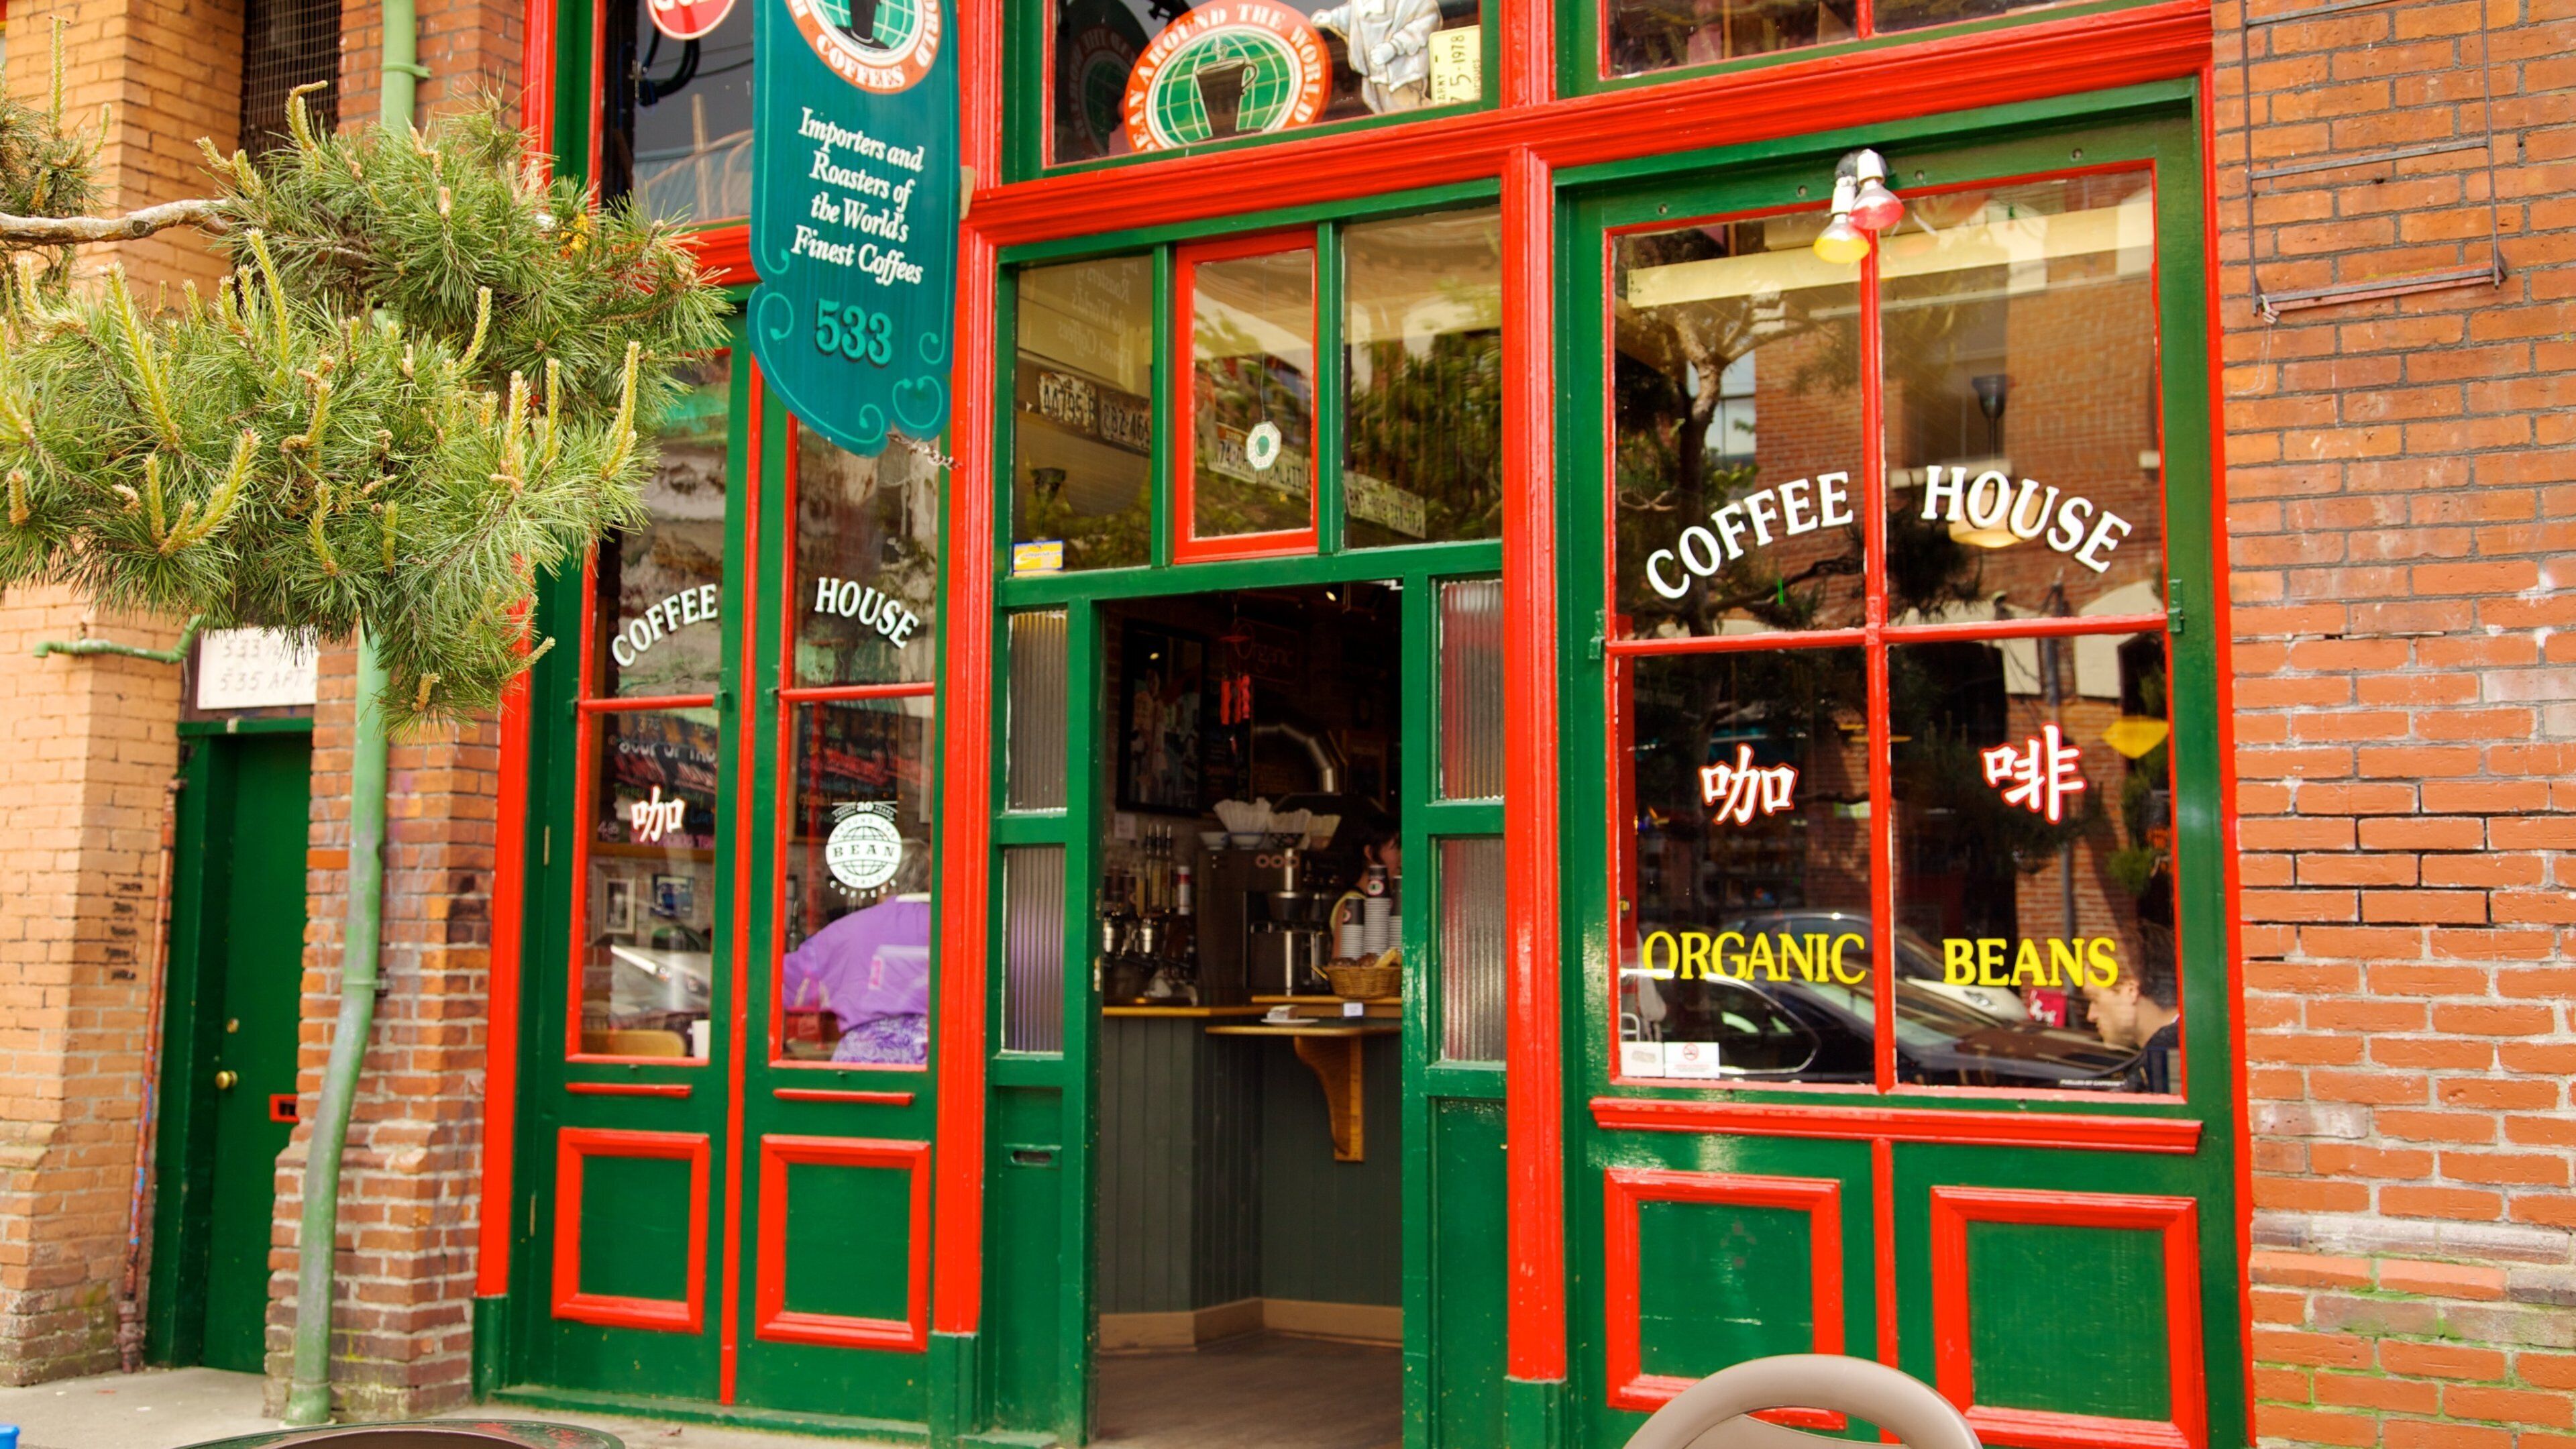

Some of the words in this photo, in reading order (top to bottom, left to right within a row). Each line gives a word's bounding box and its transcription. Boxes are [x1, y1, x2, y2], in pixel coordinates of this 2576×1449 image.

[816, 34, 905, 89] COFFEES
[1138, 8, 1227, 85] AROUND
[1237, 4, 1286, 31] THE
[1289, 25, 1322, 123] WORLD
[798, 107, 887, 160] Importers
[887, 146, 925, 172] and
[808, 150, 891, 200] Roasters
[893, 178, 916, 213] of
[811, 191, 841, 223] the
[843, 197, 910, 243] World's
[791, 224, 855, 267] Finest
[858, 243, 924, 286] Coffees
[815, 298, 893, 368] 533
[1646, 471, 1854, 600] COFFEE
[1921, 465, 2132, 574] HOUSE
[611, 584, 718, 667] COFFEE
[814, 577, 920, 649] HOUSE
[1698, 744, 1799, 825] 咖
[1981, 722, 2088, 825] 啡
[631, 785, 686, 843] 咖
[857, 801, 873, 812] 20
[833, 844, 894, 857] BEAN
[1642, 931, 1866, 985] ORGANIC
[1943, 936, 2120, 987] BEANS
